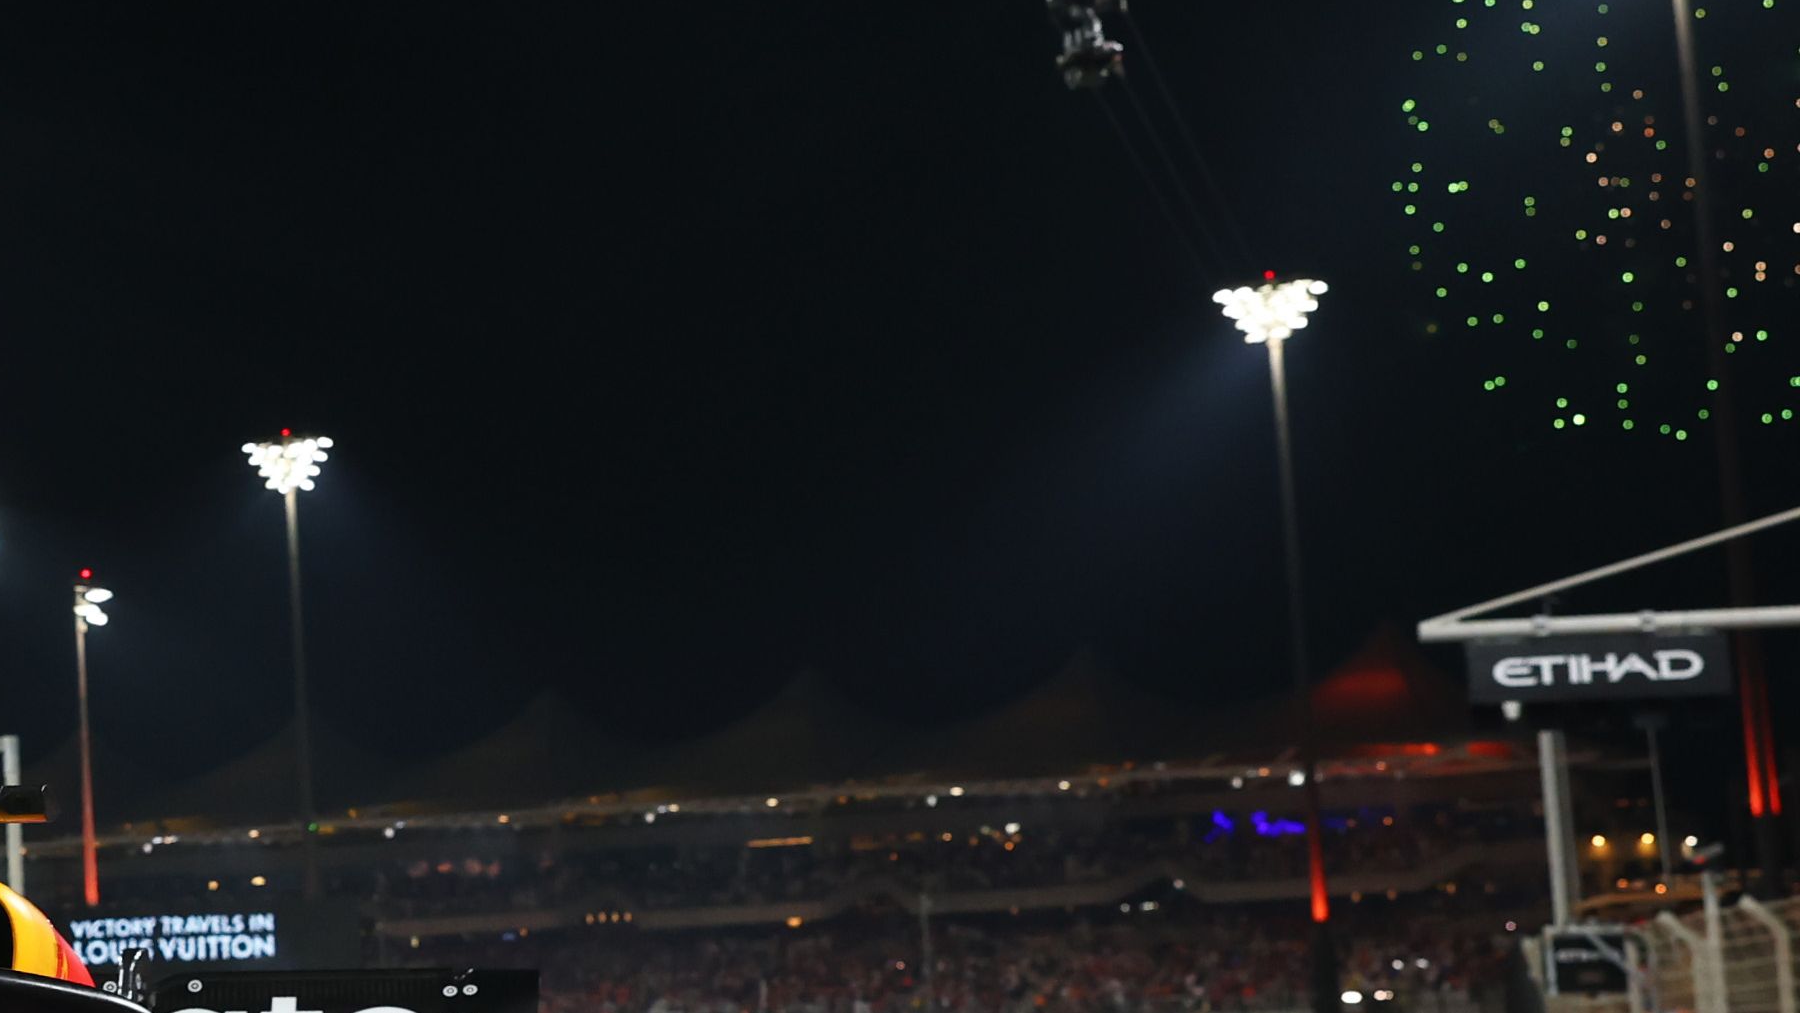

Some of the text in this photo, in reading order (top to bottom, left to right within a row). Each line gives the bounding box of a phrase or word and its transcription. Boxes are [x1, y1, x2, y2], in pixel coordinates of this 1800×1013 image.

[1492, 649, 1705, 688] ETIHAD
[70, 913, 276, 939] VICTORY TRAVELS IN
[157, 934, 277, 962] VUITTON
